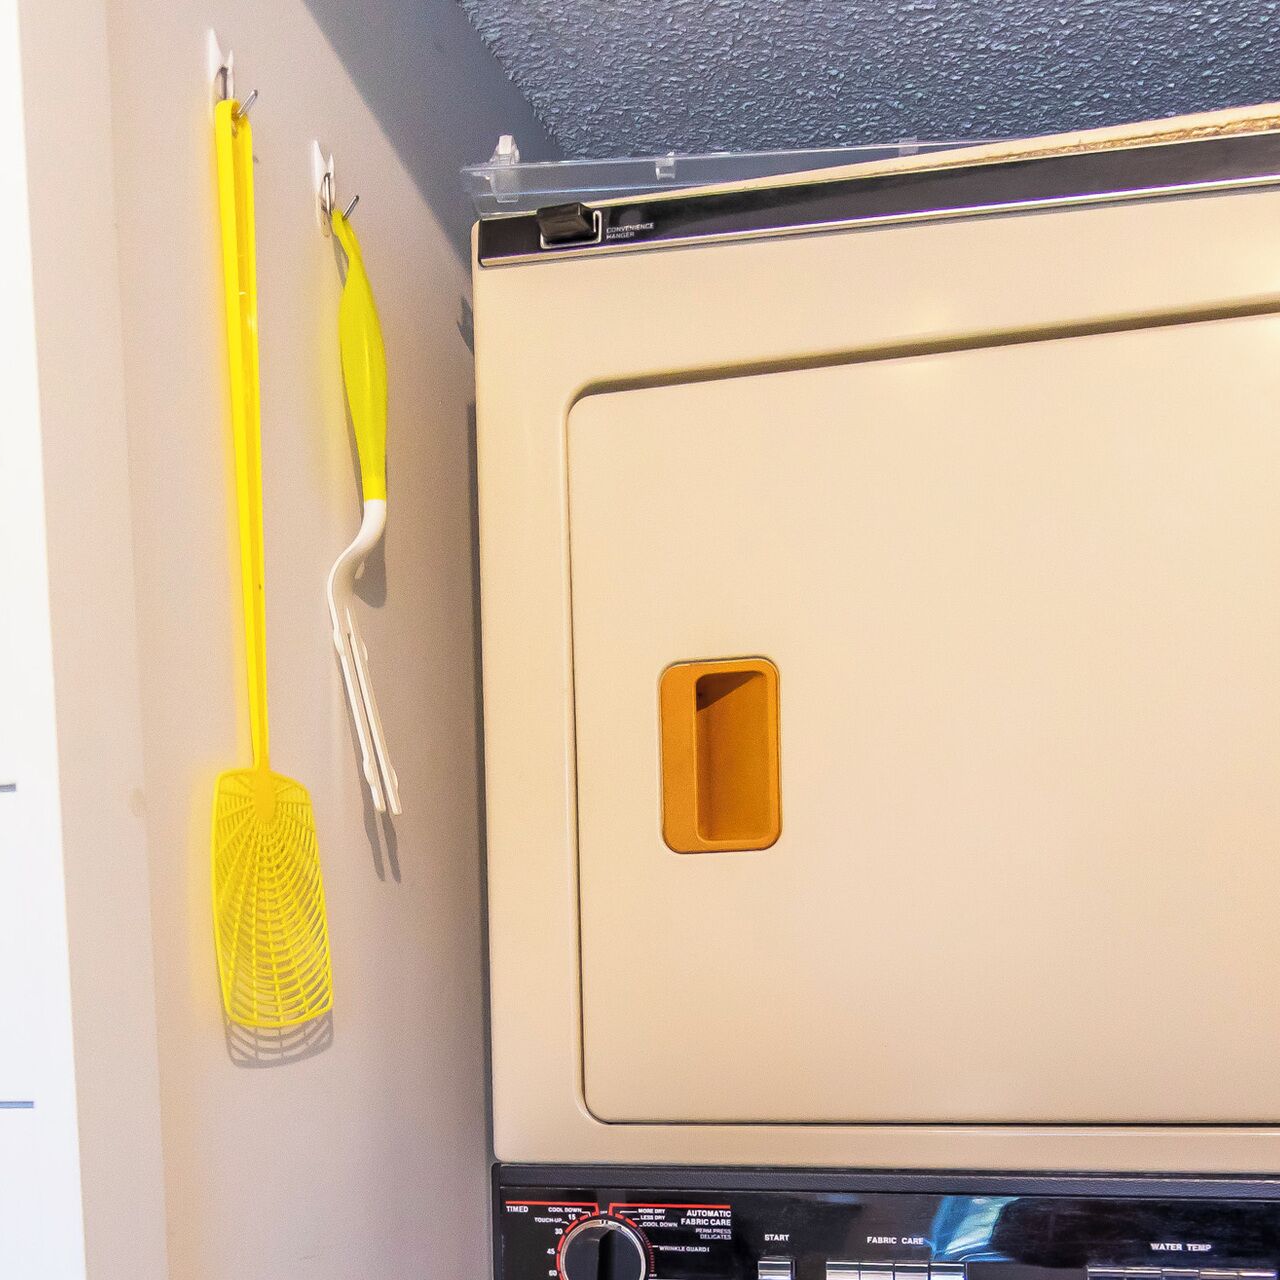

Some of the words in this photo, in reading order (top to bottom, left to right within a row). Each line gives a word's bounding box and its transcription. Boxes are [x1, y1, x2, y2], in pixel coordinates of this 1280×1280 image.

[606, 222, 654, 234] CONVENIENCE
[606, 232, 635, 240] HANGER
[686, 1210, 732, 1218] AUTOMATIC
[680, 1218, 709, 1226] FABRIC
[764, 1234, 790, 1242] START
[867, 1236, 896, 1244] FABRIC
[1150, 1242, 1182, 1251] WATER
[1186, 1244, 1212, 1252] TEMP
